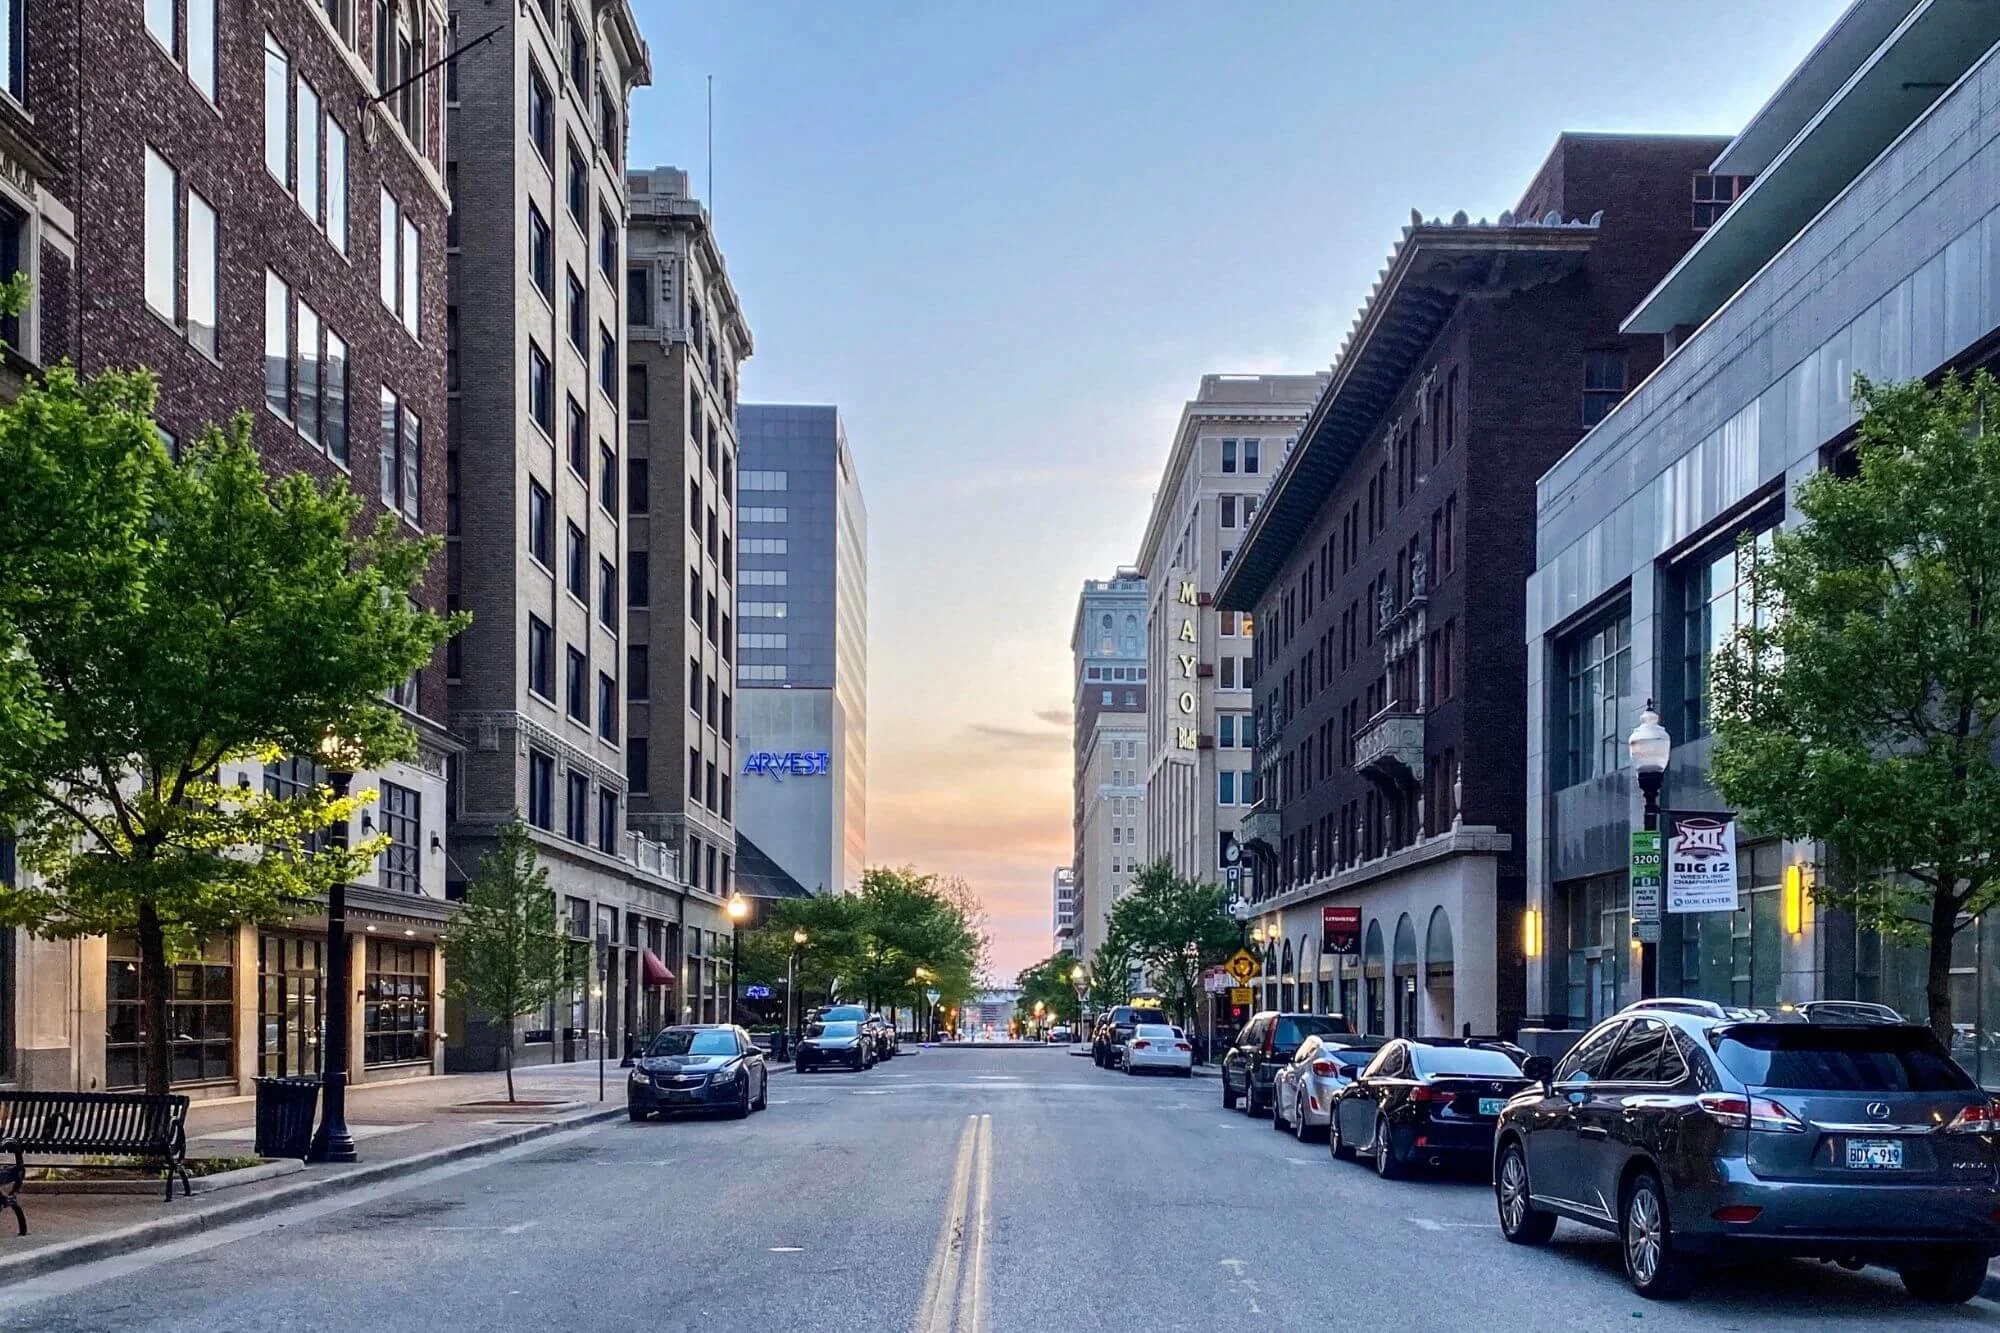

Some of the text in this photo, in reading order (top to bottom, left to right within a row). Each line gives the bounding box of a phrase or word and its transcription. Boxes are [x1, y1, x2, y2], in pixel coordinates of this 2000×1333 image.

[741, 752, 828, 781] ARVEST
[1633, 854, 1660, 865] 3200
[1674, 863, 1730, 873] BIG 12
